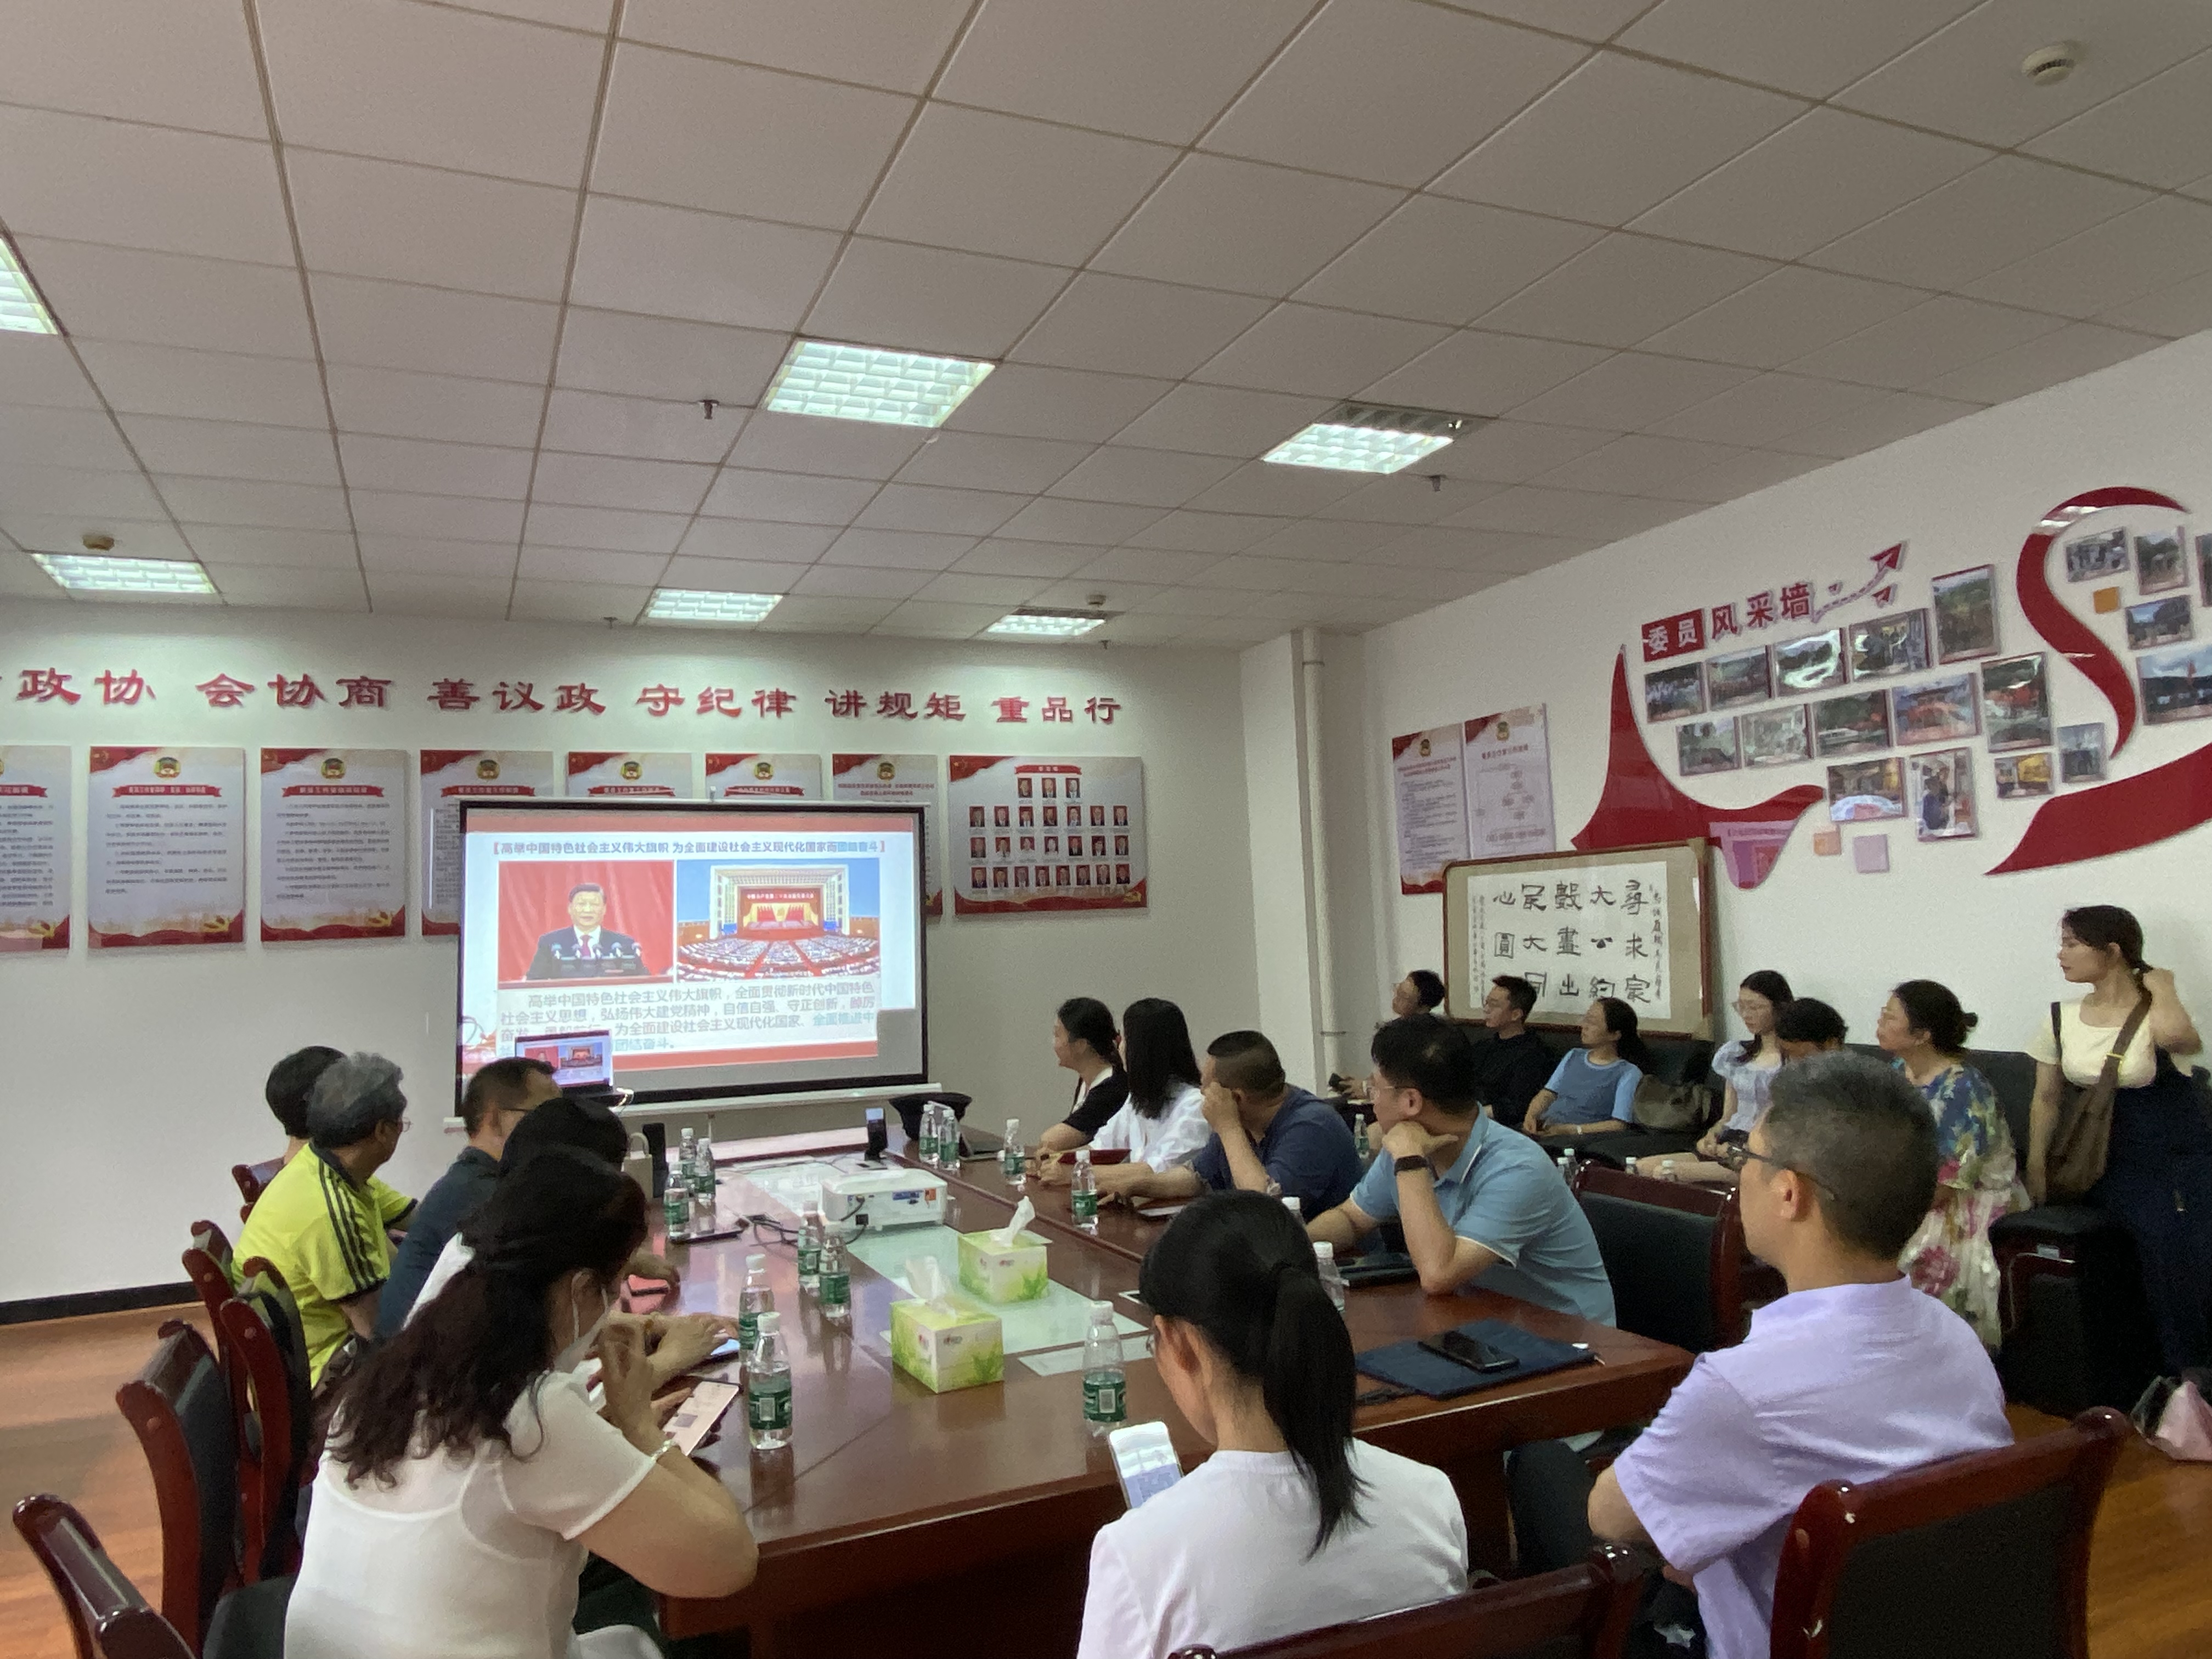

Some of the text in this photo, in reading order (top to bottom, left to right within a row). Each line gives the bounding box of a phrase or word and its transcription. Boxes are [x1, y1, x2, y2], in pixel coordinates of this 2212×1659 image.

[1643, 583, 1810, 655] 委员风采墙
[196, 673, 393, 709] 会协商
[427, 678, 607, 714] 善议政
[636, 682, 797, 719] 守纪律
[825, 689, 966, 723] 讲规矩
[992, 696, 1122, 724] 重品行
